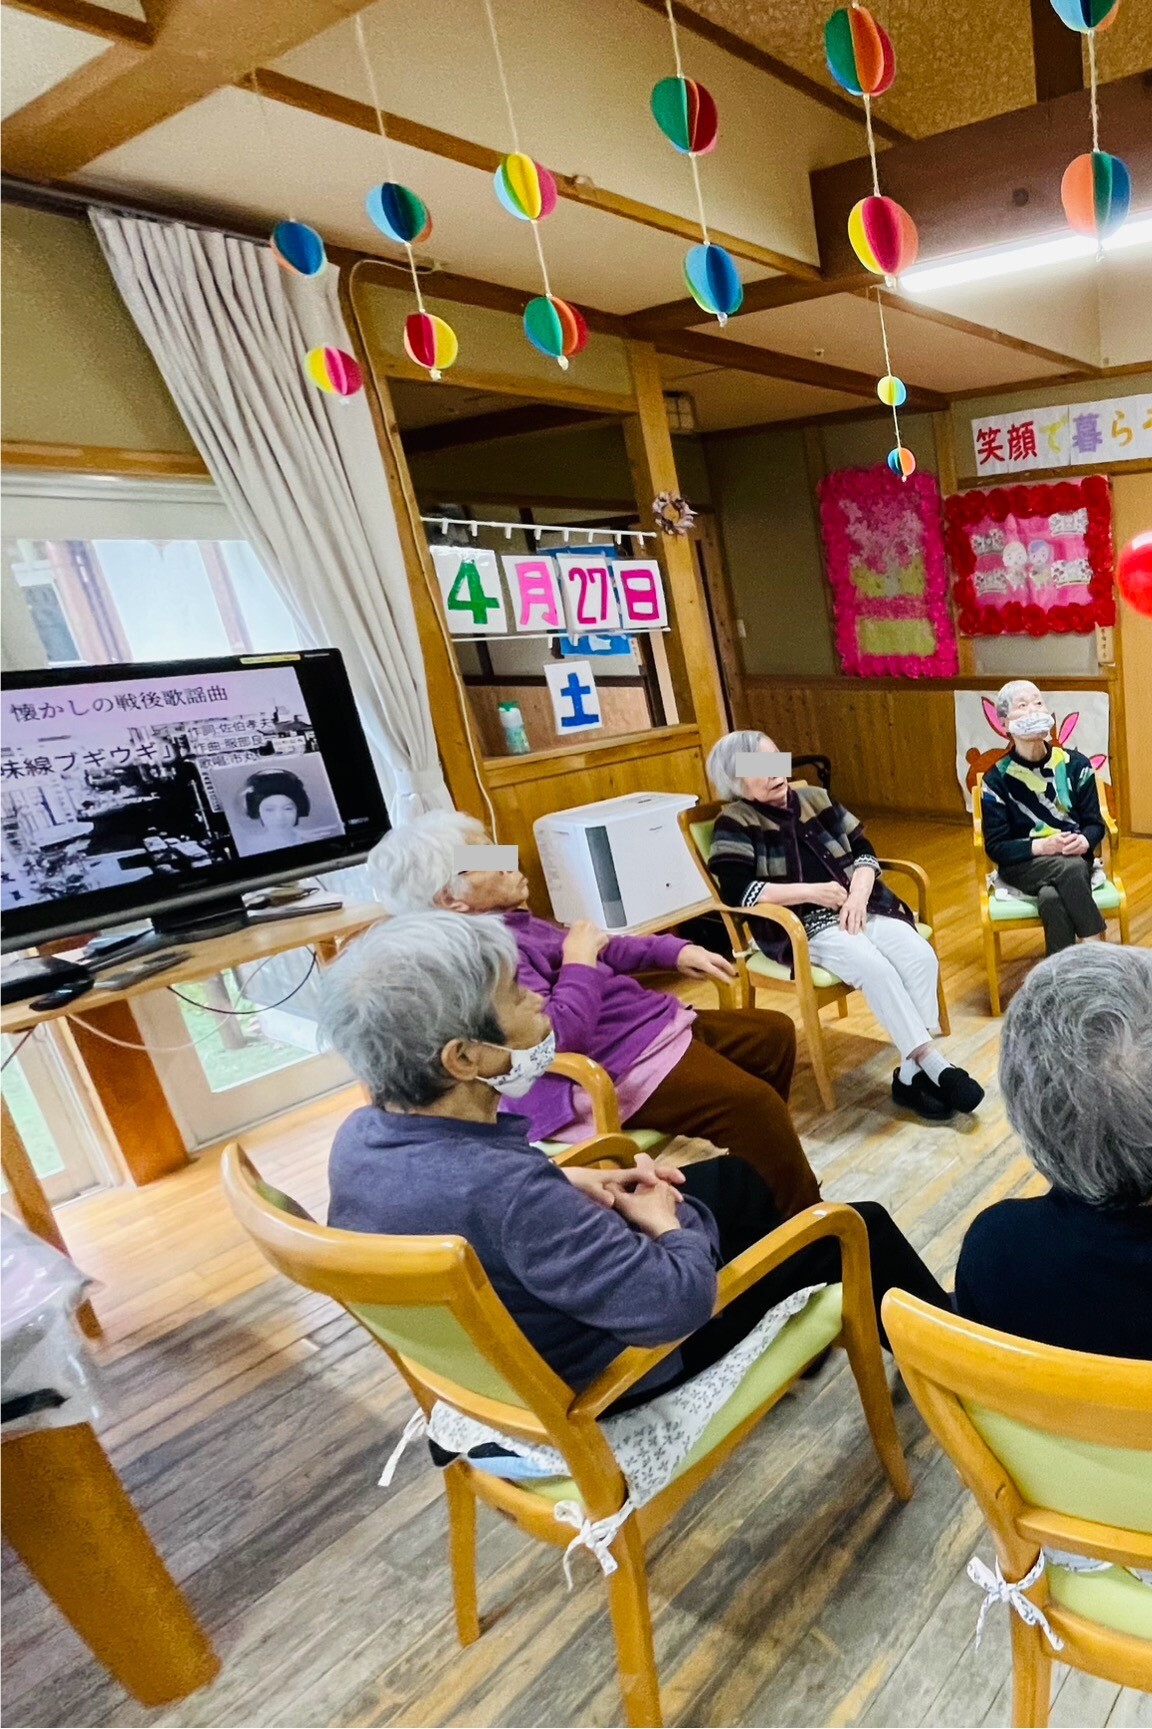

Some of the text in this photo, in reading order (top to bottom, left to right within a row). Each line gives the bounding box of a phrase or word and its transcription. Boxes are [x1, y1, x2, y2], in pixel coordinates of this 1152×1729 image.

[447, 559, 660, 626] 4月27日
[10, 685, 228, 723] 懐かしの戦後歌謡曲
[561, 672, 600, 728] 土
